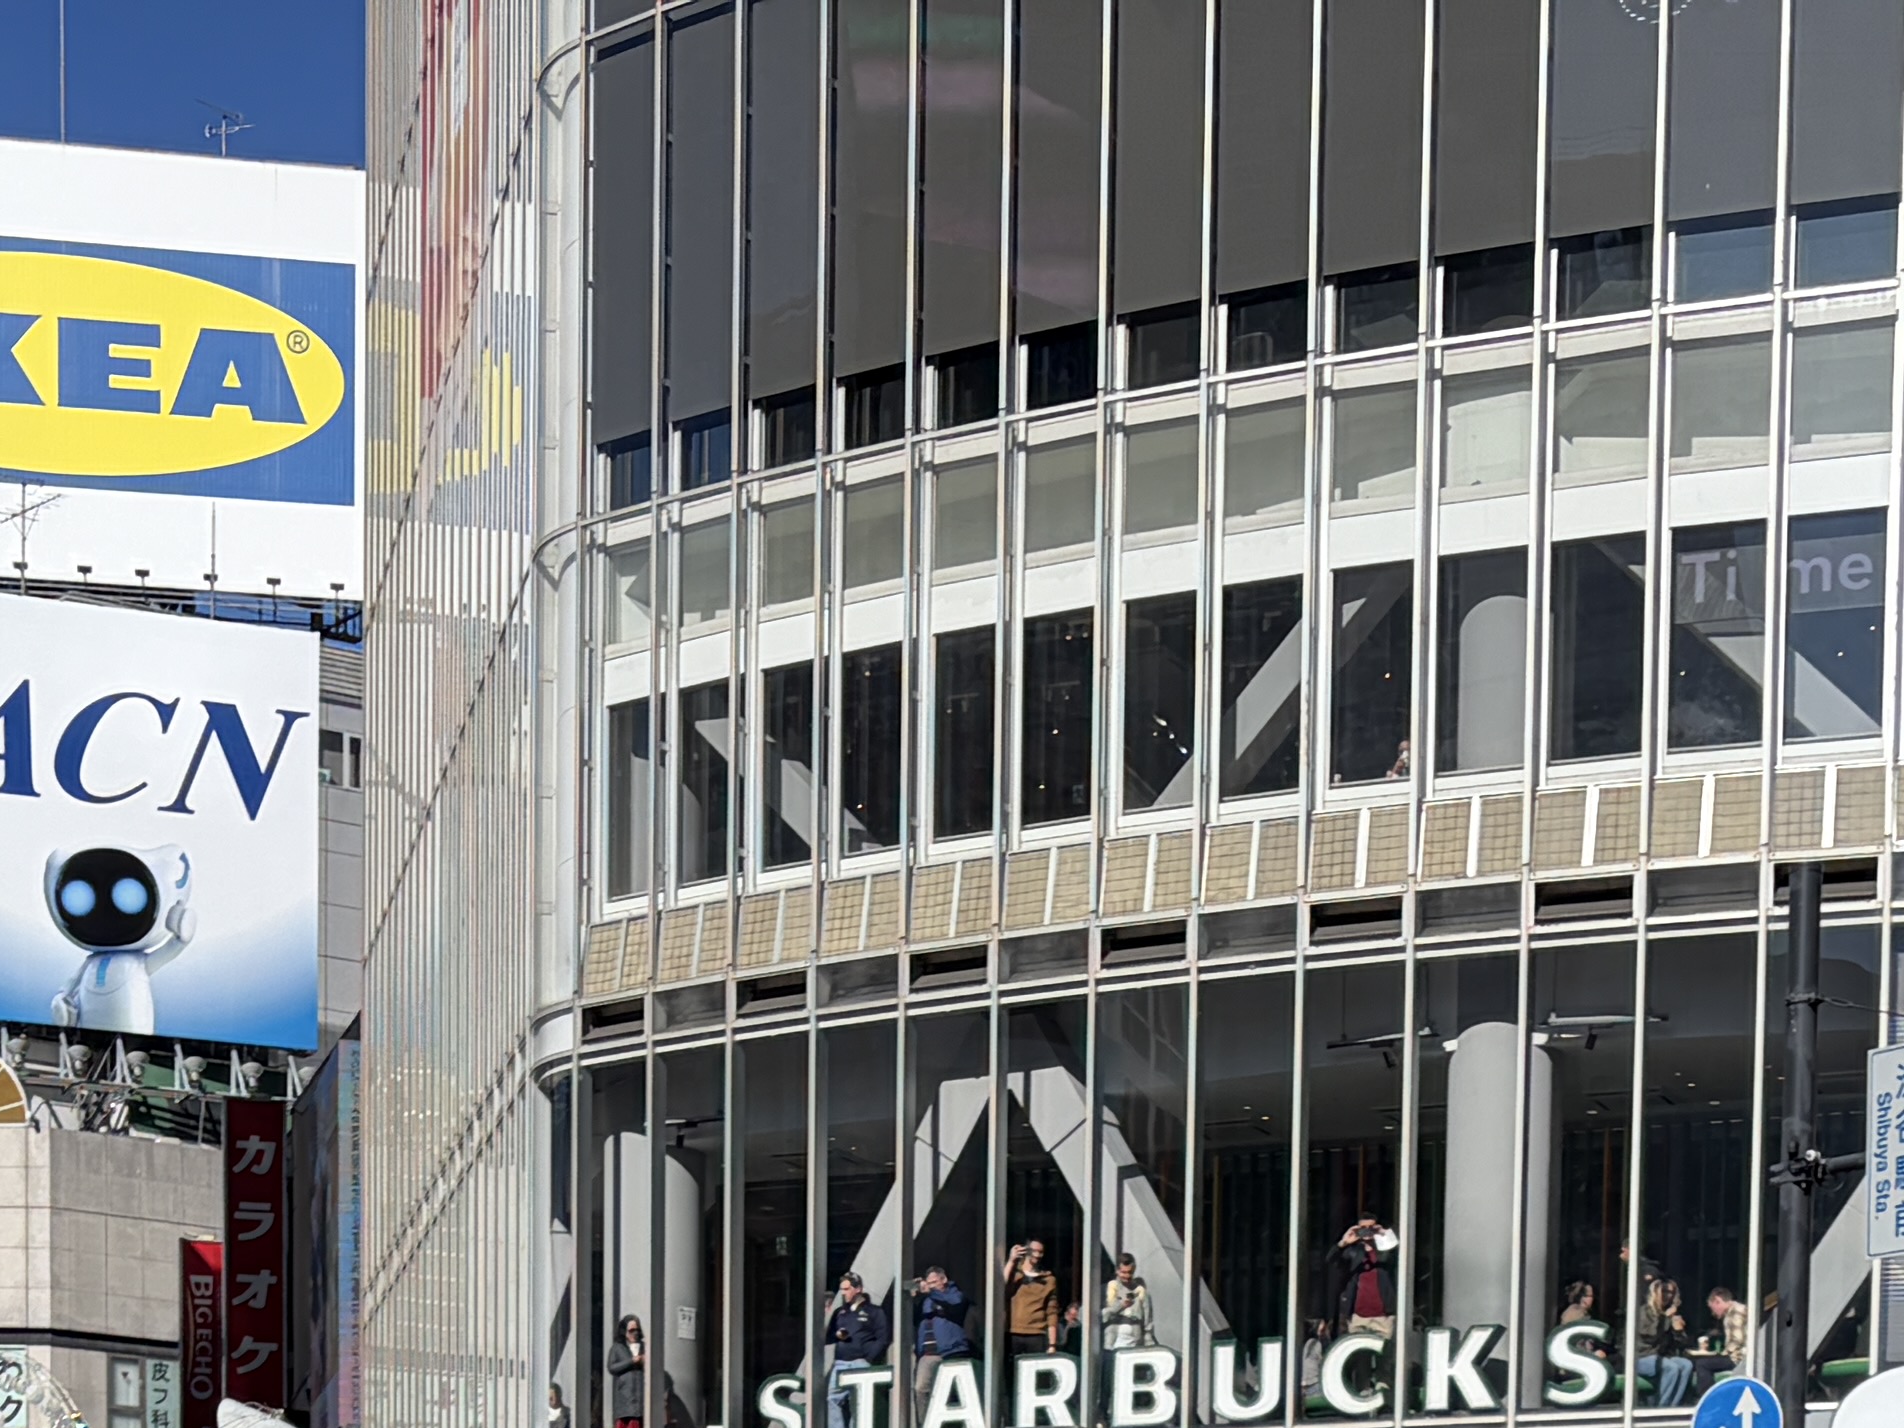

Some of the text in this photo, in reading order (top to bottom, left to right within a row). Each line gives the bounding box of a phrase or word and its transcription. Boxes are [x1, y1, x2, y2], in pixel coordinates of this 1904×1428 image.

[1680, 550, 1874, 606] Time
[1872, 1092, 1894, 1221] Shibuya Sta.
[230, 1136, 280, 1375] カラオケ
[189, 1274, 214, 1400] BIG ECHO
